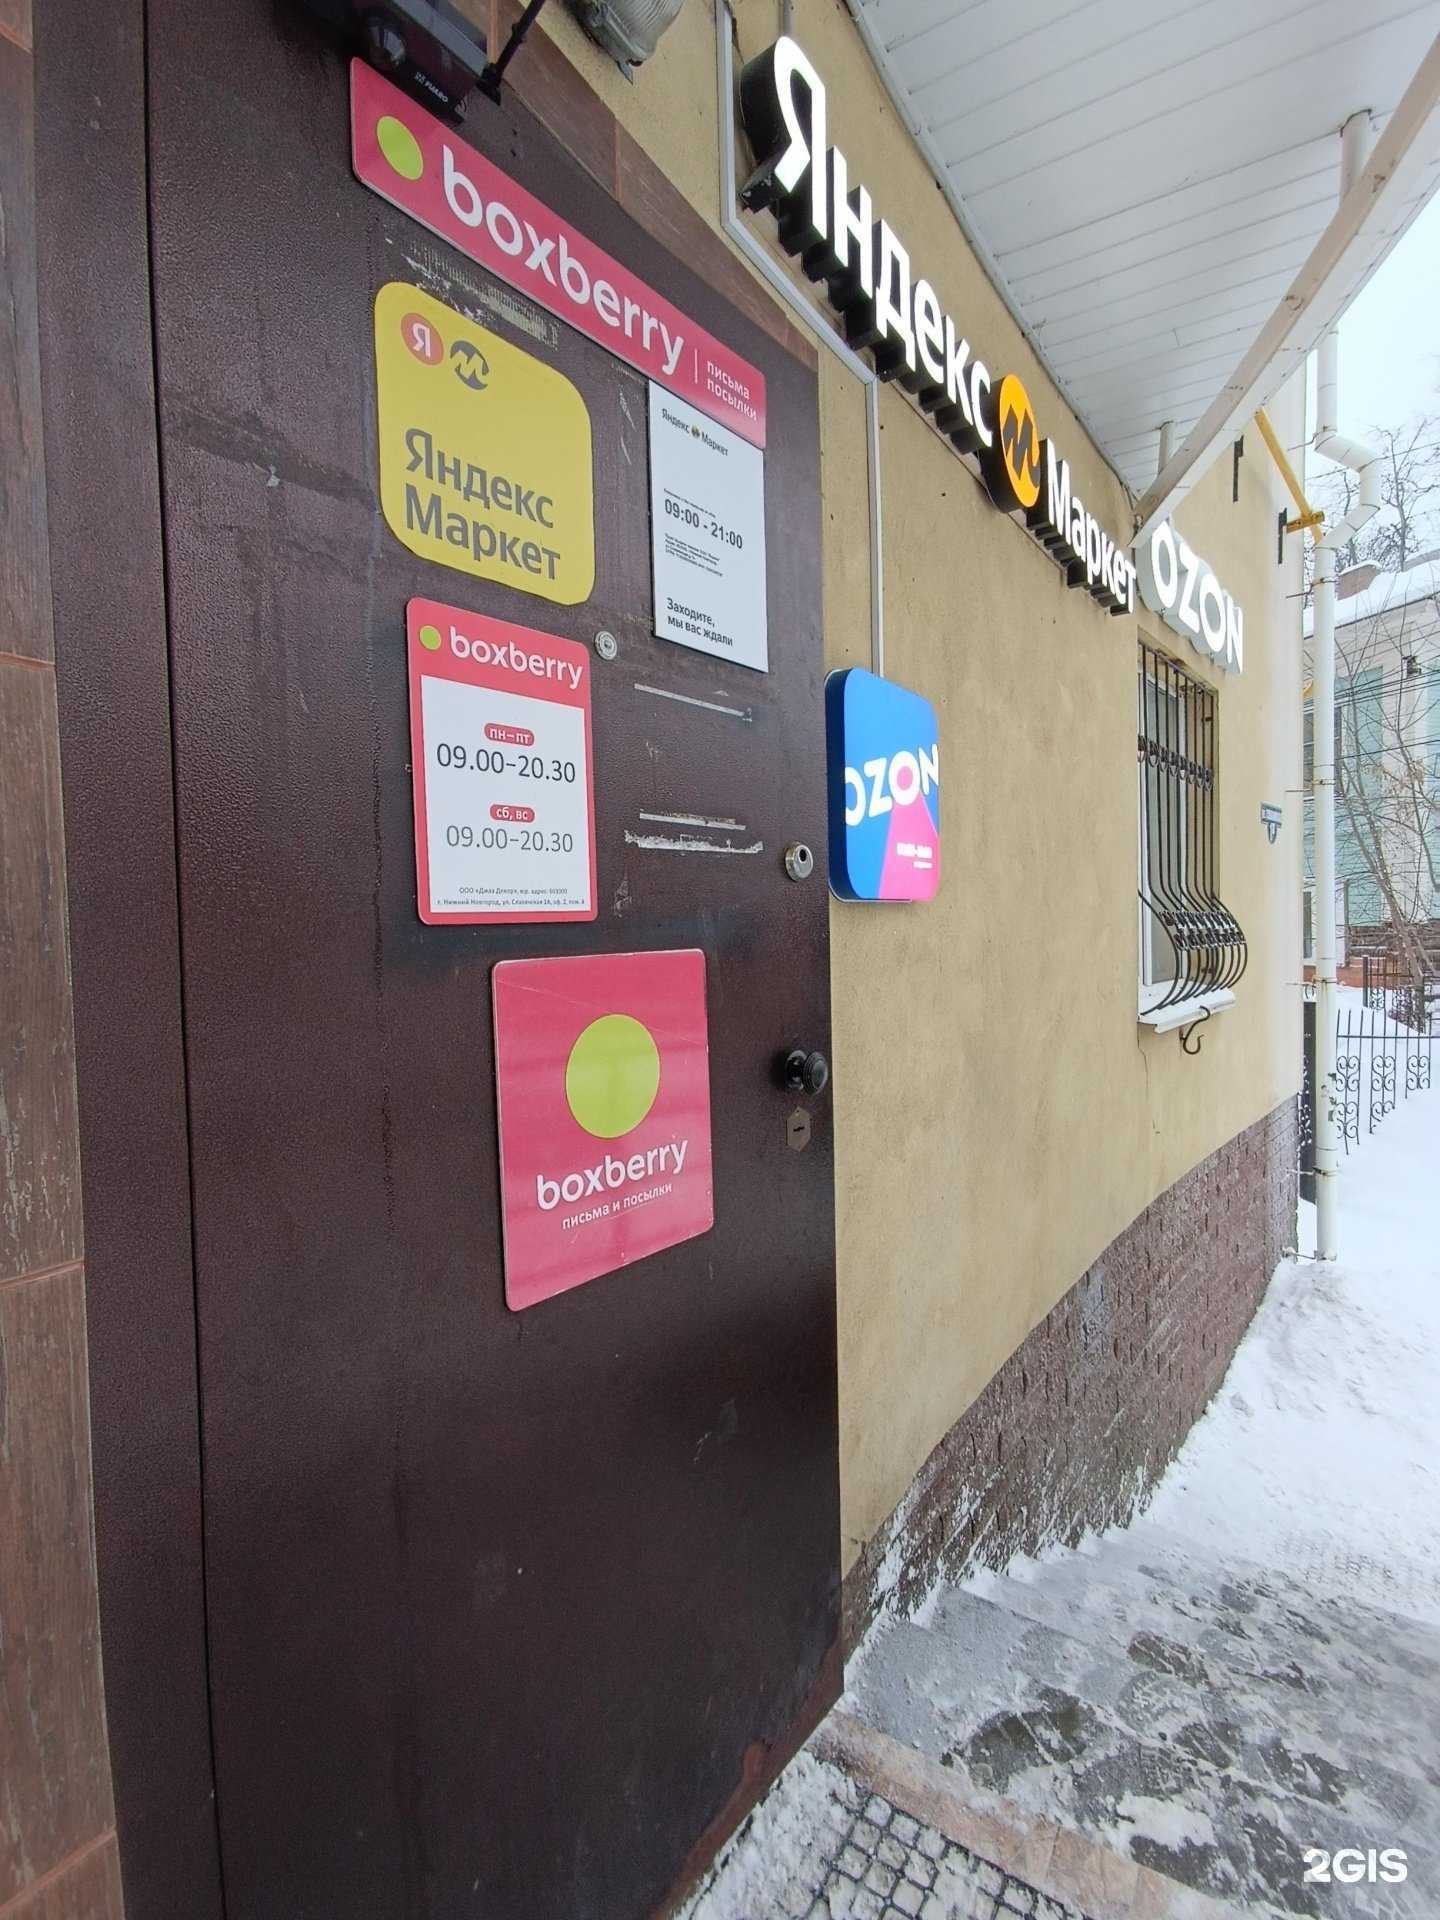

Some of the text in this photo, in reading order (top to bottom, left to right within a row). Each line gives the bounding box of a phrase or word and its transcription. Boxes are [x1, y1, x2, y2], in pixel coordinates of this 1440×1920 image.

[442, 144, 685, 375] boxberry
[773, 35, 992, 448] Яндекс
[1046, 438, 1136, 613] Маркет
[706, 359, 751, 400] письма
[706, 378, 758, 421] посылки
[661, 407, 729, 457] Яндекс Маркет
[404, 427, 554, 529] Яндекс
[404, 482, 561, 580] Маркет
[664, 498, 700, 528] 09:00
[711, 522, 743, 549] 21:00
[666, 597, 716, 627] Заходите,
[1151, 519, 1243, 674] OZON
[667, 615, 734, 647] мы вас ждали
[449, 625, 584, 690] boxberry
[436, 742, 576, 784] 09.00-20.30
[445, 824, 573, 853] 09.00-20.30
[516, 808, 529, 820] вс
[536, 1138, 689, 1211] boxberry
[562, 1182, 673, 1231] письма и посылки
